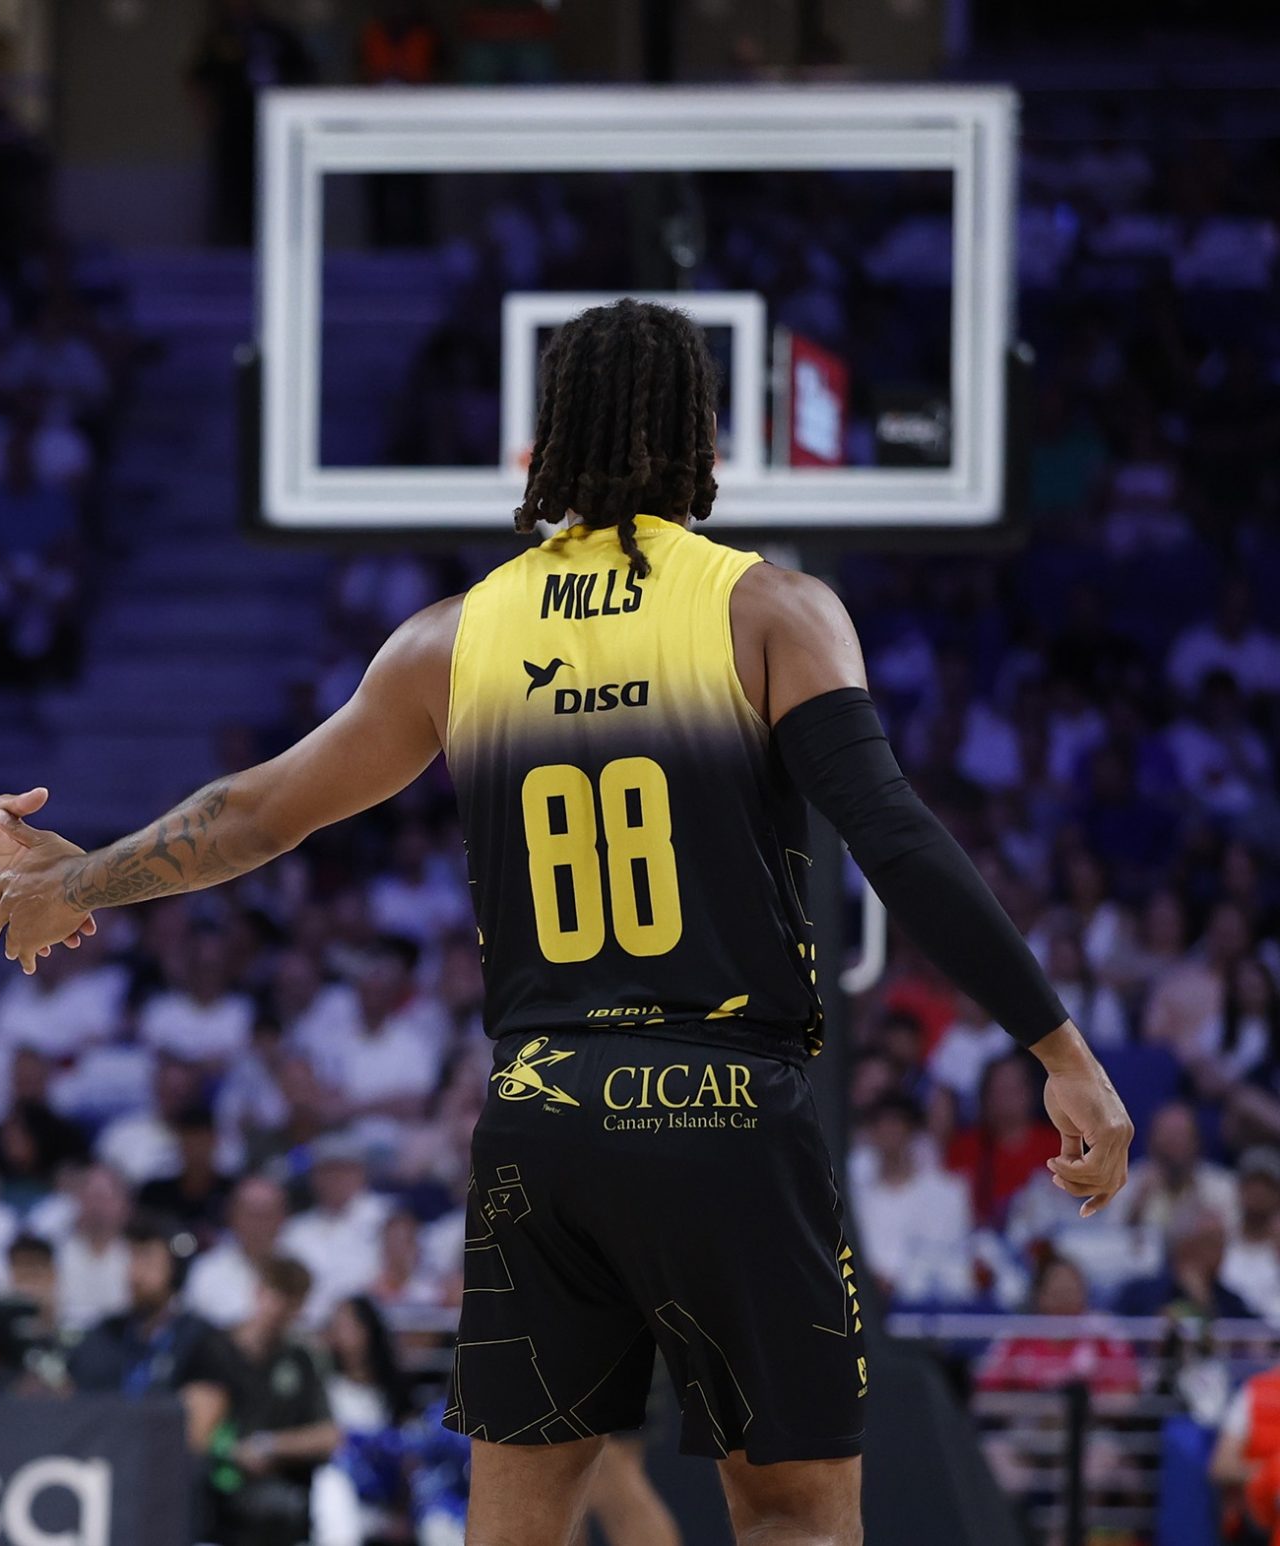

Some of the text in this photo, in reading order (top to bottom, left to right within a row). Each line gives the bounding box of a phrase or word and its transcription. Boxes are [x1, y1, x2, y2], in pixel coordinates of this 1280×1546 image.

[540, 569, 651, 620] MILLS
[522, 757, 682, 964] 88
[587, 1005, 663, 1018] IBERIA
[603, 1064, 758, 1110] CICAR
[603, 1111, 758, 1134] Canary Islands Car
